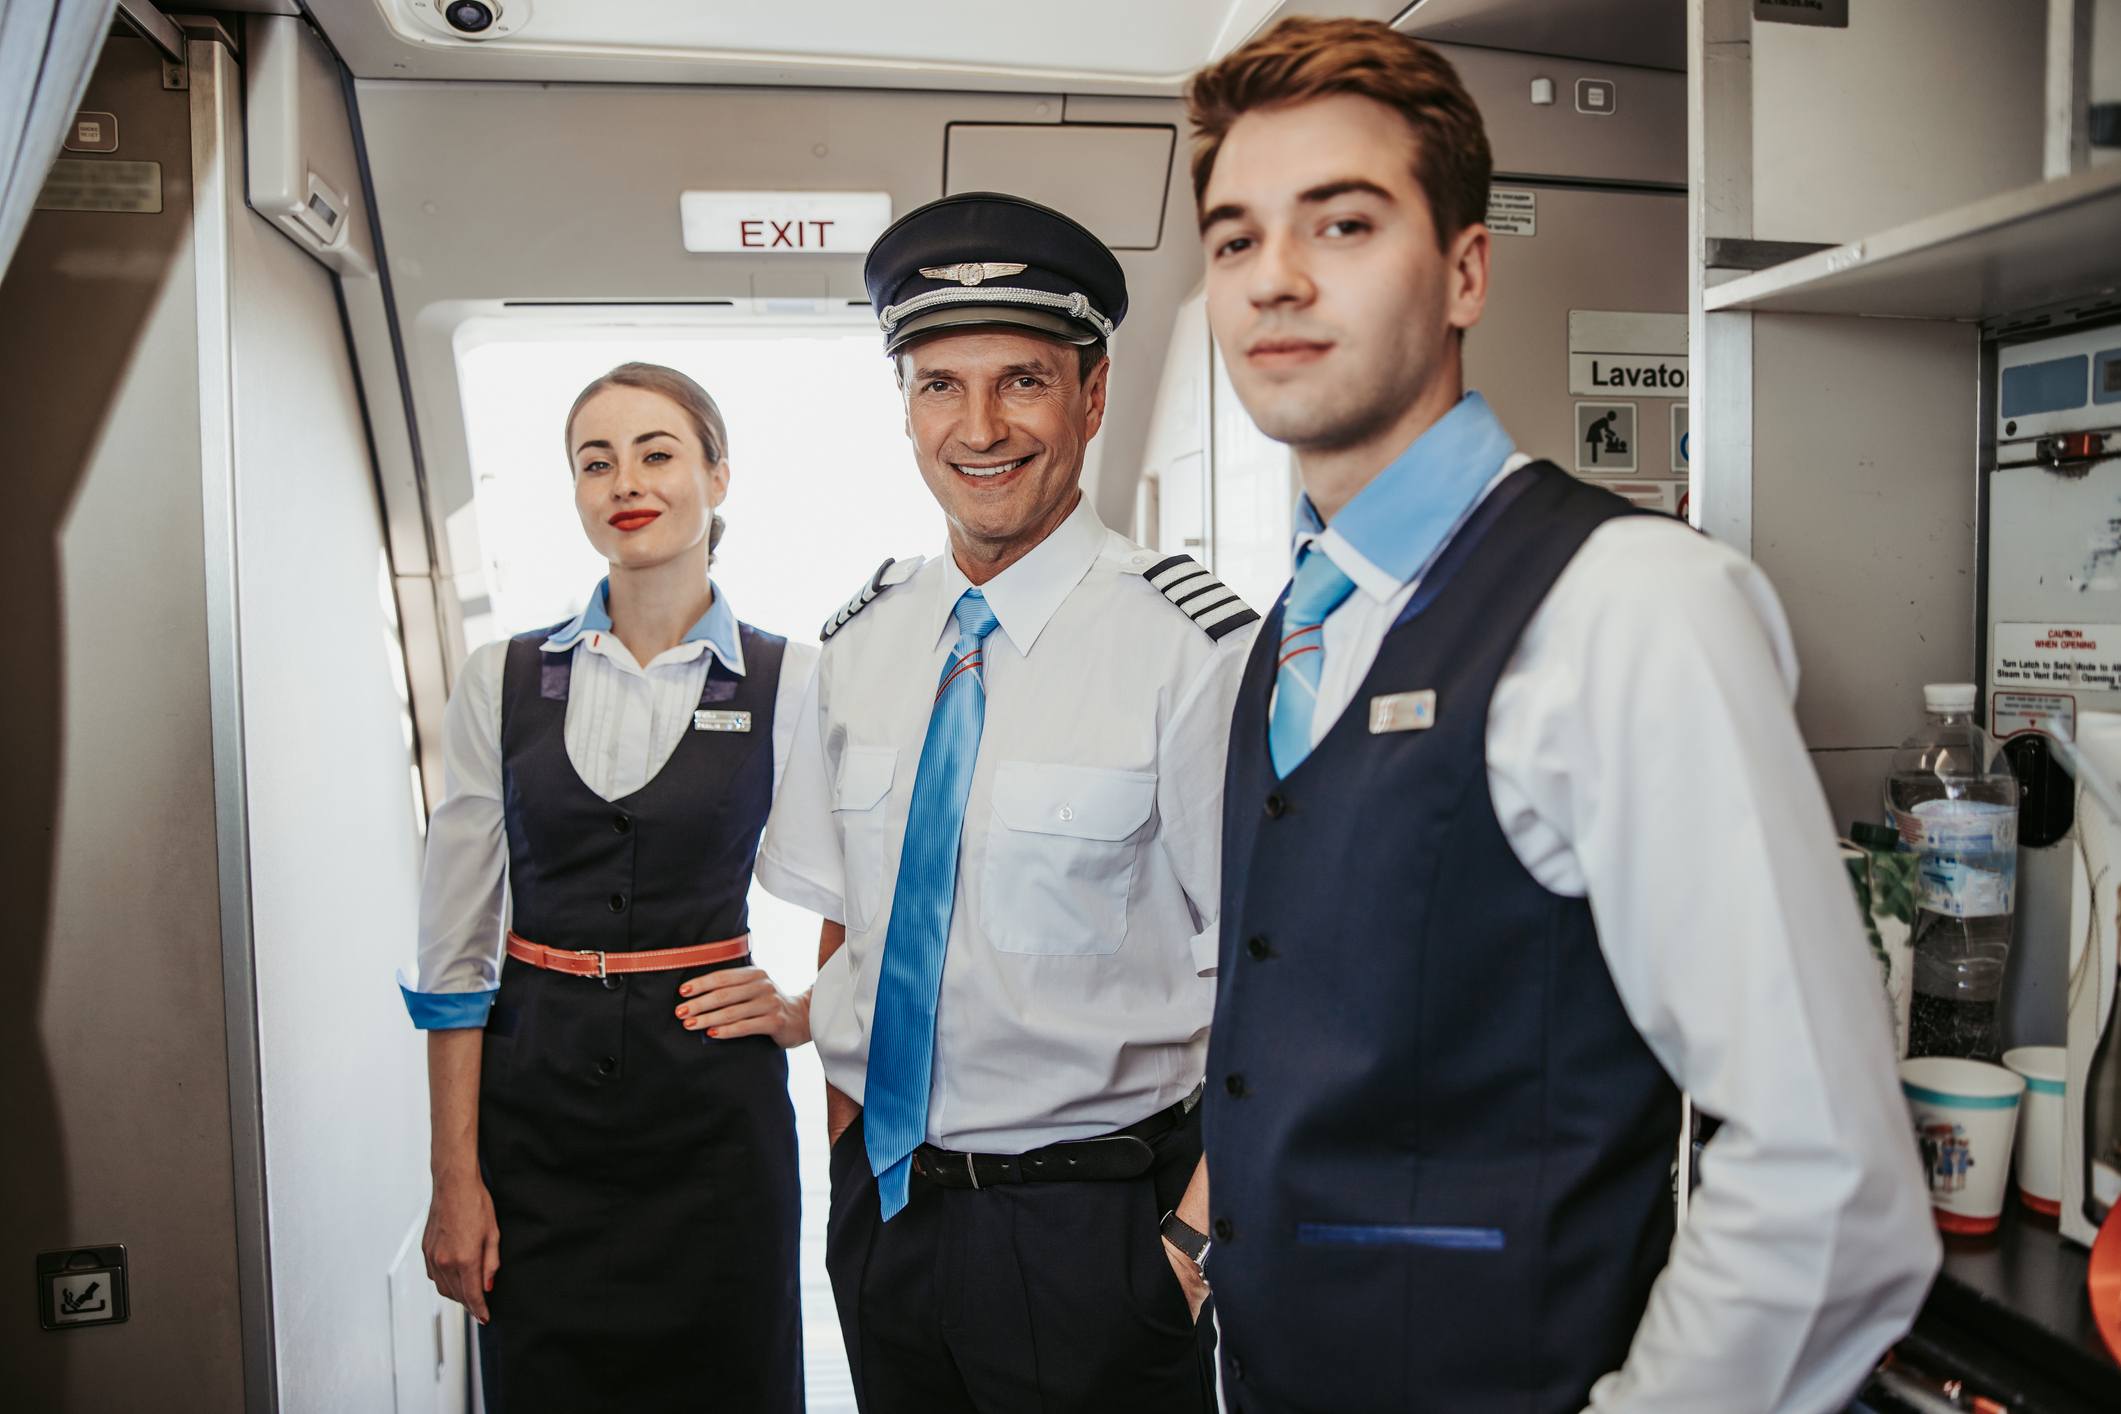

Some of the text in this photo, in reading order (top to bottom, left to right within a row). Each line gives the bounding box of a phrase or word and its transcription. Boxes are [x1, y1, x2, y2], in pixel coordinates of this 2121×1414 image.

[741, 221, 834, 247] EXIT
[1592, 361, 1689, 388] Lavato
[2048, 630, 2082, 638] CAUTION
[2035, 640, 2097, 650] WHEN OPENING
[2002, 659, 2016, 668] Turn
[2019, 660, 2040, 669] Latch
[2043, 661, 2050, 669] to
[2100, 663, 2108, 671] to
[1997, 669, 2020, 678] Steam
[2022, 671, 2030, 679] to
[2033, 671, 2049, 680] Vent
[2081, 673, 2115, 685] Opening
